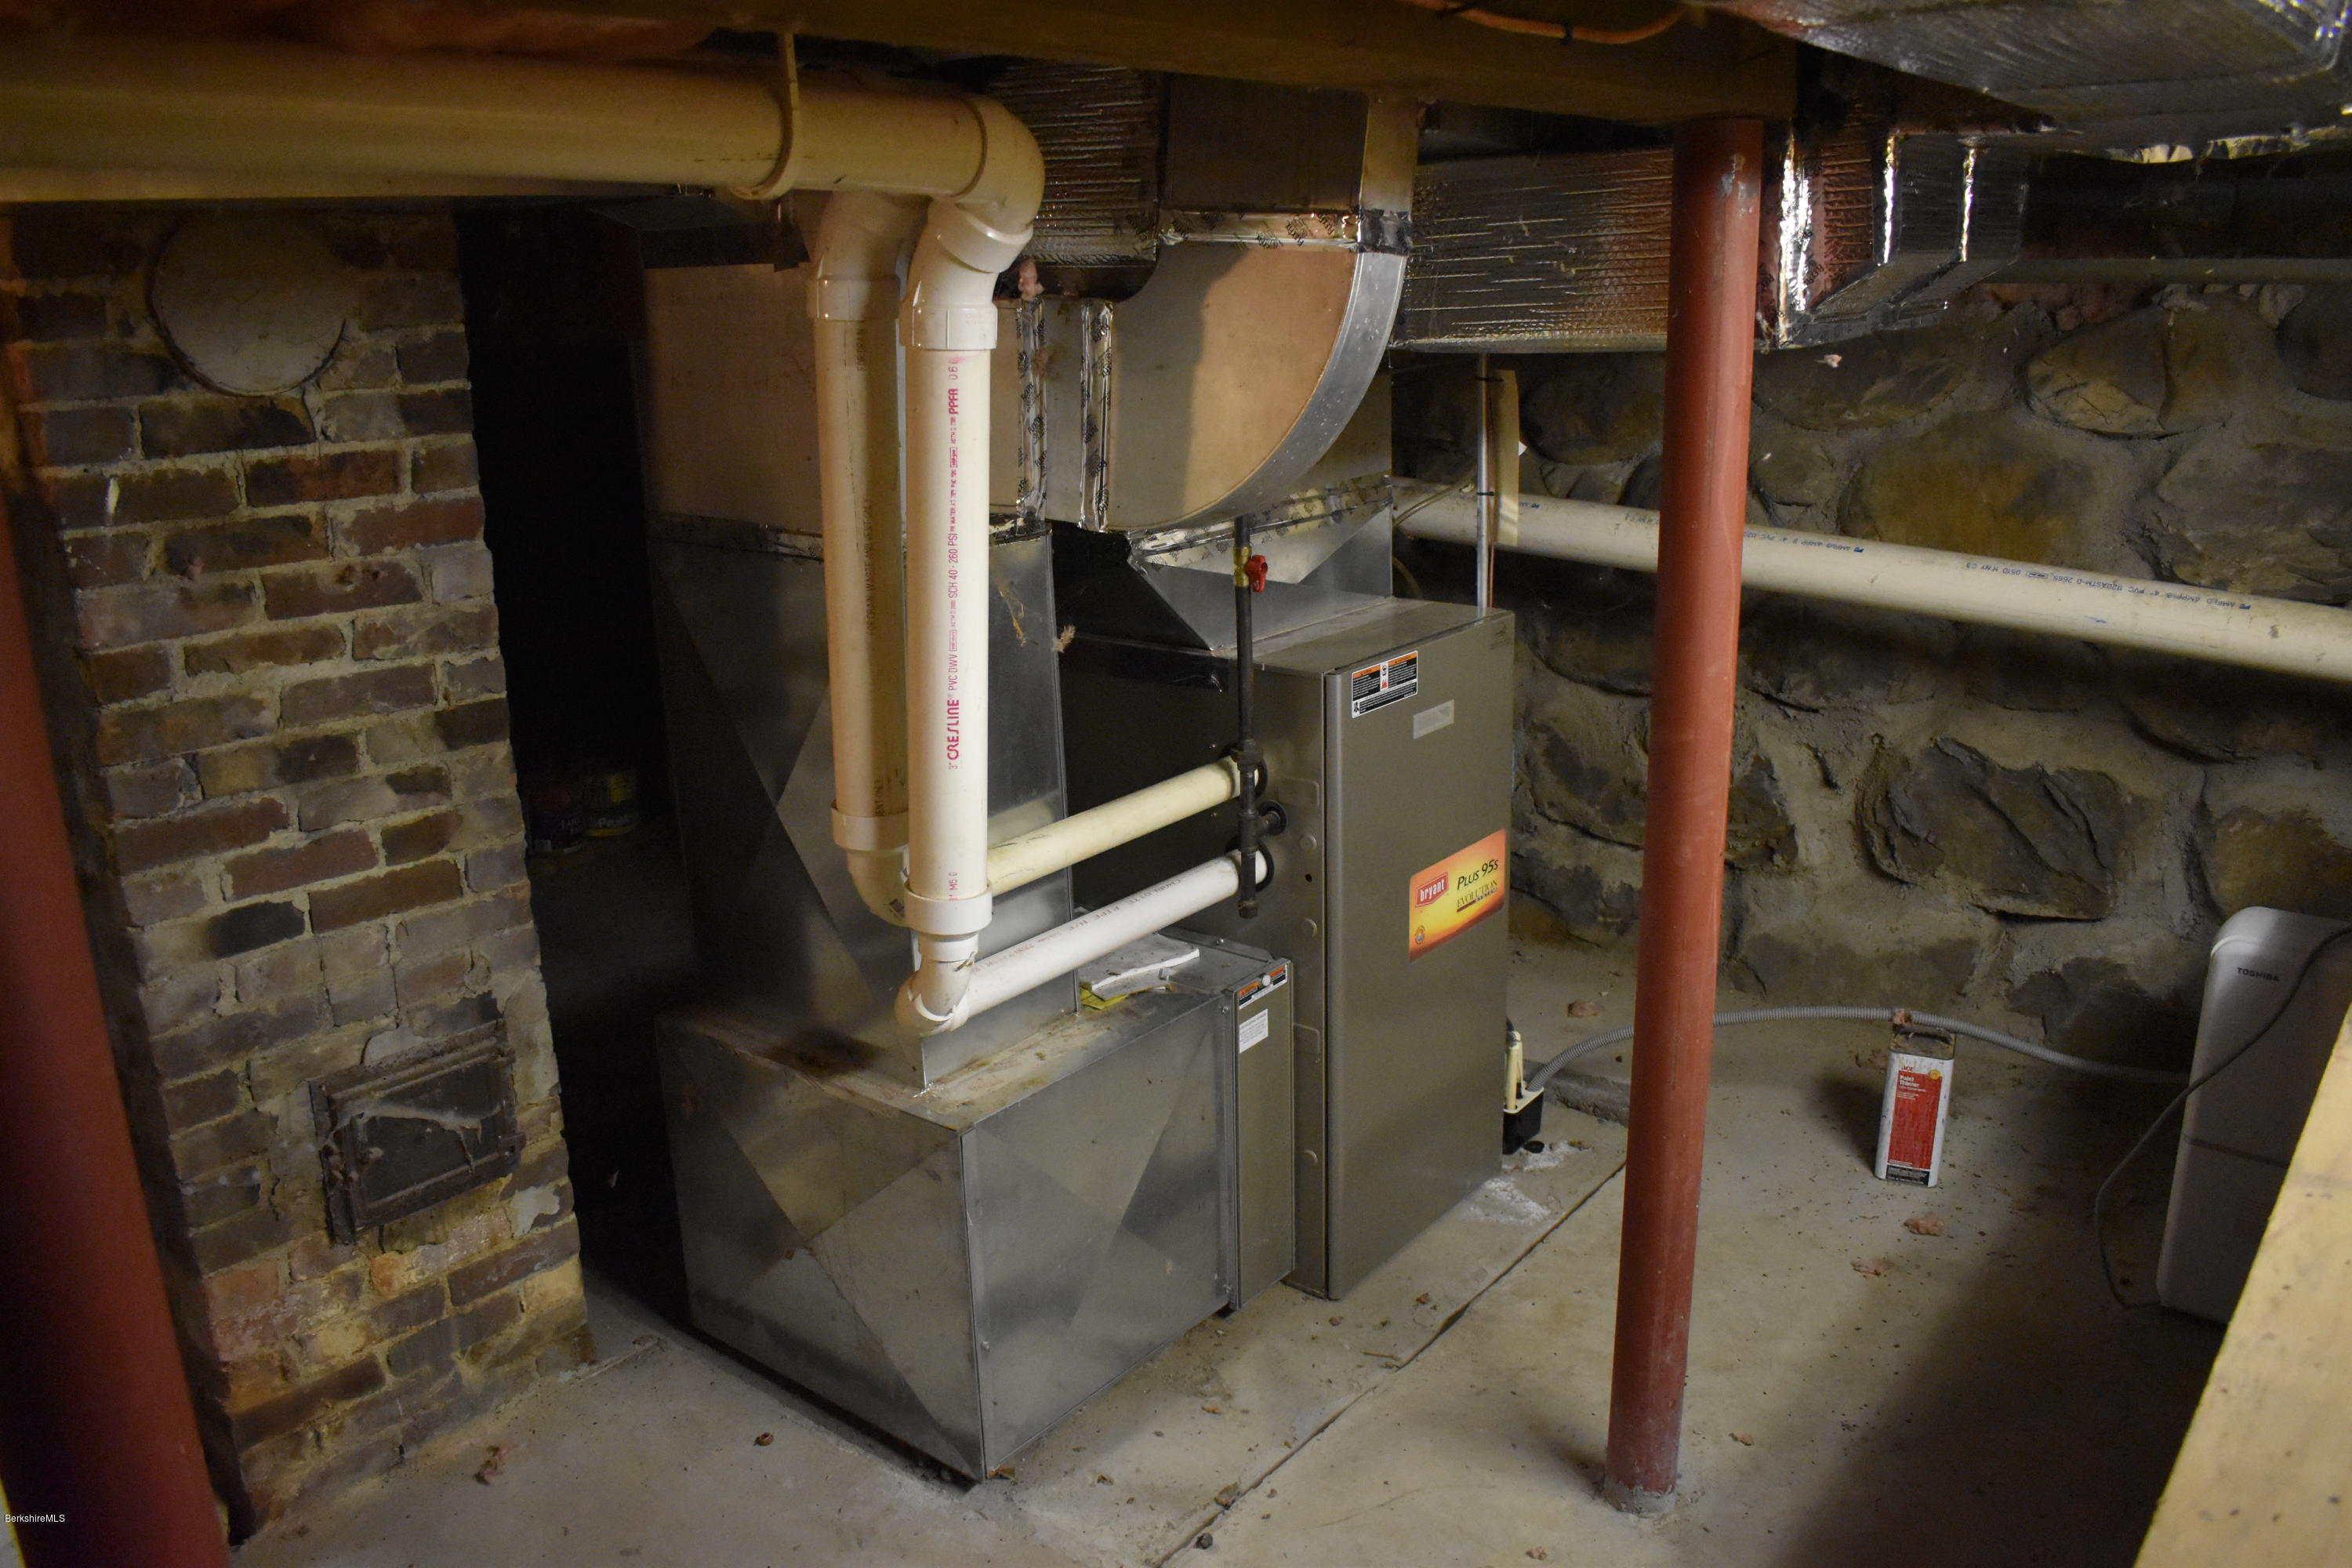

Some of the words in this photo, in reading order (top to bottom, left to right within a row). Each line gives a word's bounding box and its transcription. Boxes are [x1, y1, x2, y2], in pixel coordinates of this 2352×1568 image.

[948, 388, 959, 415] PPFA
[948, 532, 958, 546] PSI
[948, 549, 958, 564] 260
[948, 569, 958, 580] 40
[2053, 574, 2073, 583] 2665
[948, 582, 958, 598] SCH
[2128, 586, 2145, 594] PVC
[948, 654, 958, 676] DWV
[948, 677, 958, 691] PVC
[1421, 879, 1445, 902] bryant
[2236, 967, 2280, 982] TOSHIBA
